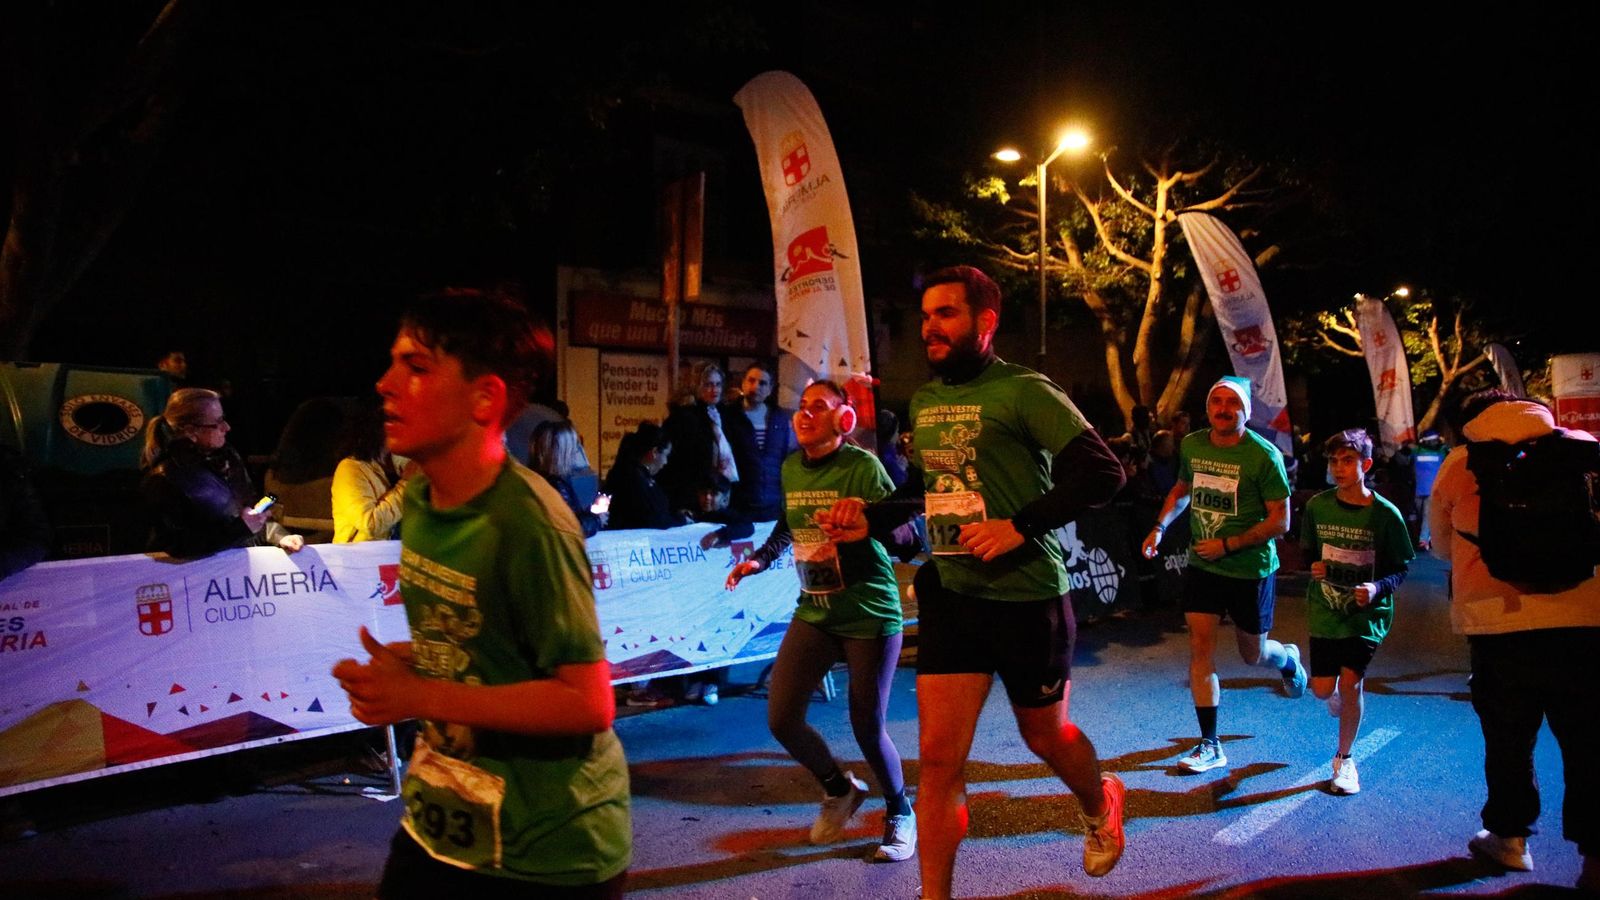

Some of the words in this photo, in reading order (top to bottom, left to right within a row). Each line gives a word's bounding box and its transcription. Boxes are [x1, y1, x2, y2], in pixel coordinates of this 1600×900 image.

[630, 299, 689, 322] Muco
[588, 322, 622, 341] que
[602, 362, 658, 378] Pensando
[602, 379, 642, 391] Vender
[647, 380, 658, 392] tu
[605, 392, 655, 405] Vivienda
[91, 425, 138, 444] VIDRIO
[1195, 491, 1232, 510] 1059
[928, 524, 961, 546] 112
[629, 541, 707, 567] ALMERÍA
[204, 565, 338, 603] ALMERÍA
[631, 568, 672, 583] CIUDAD
[24, 600, 40, 609] DE
[204, 602, 276, 624] CIUDAD
